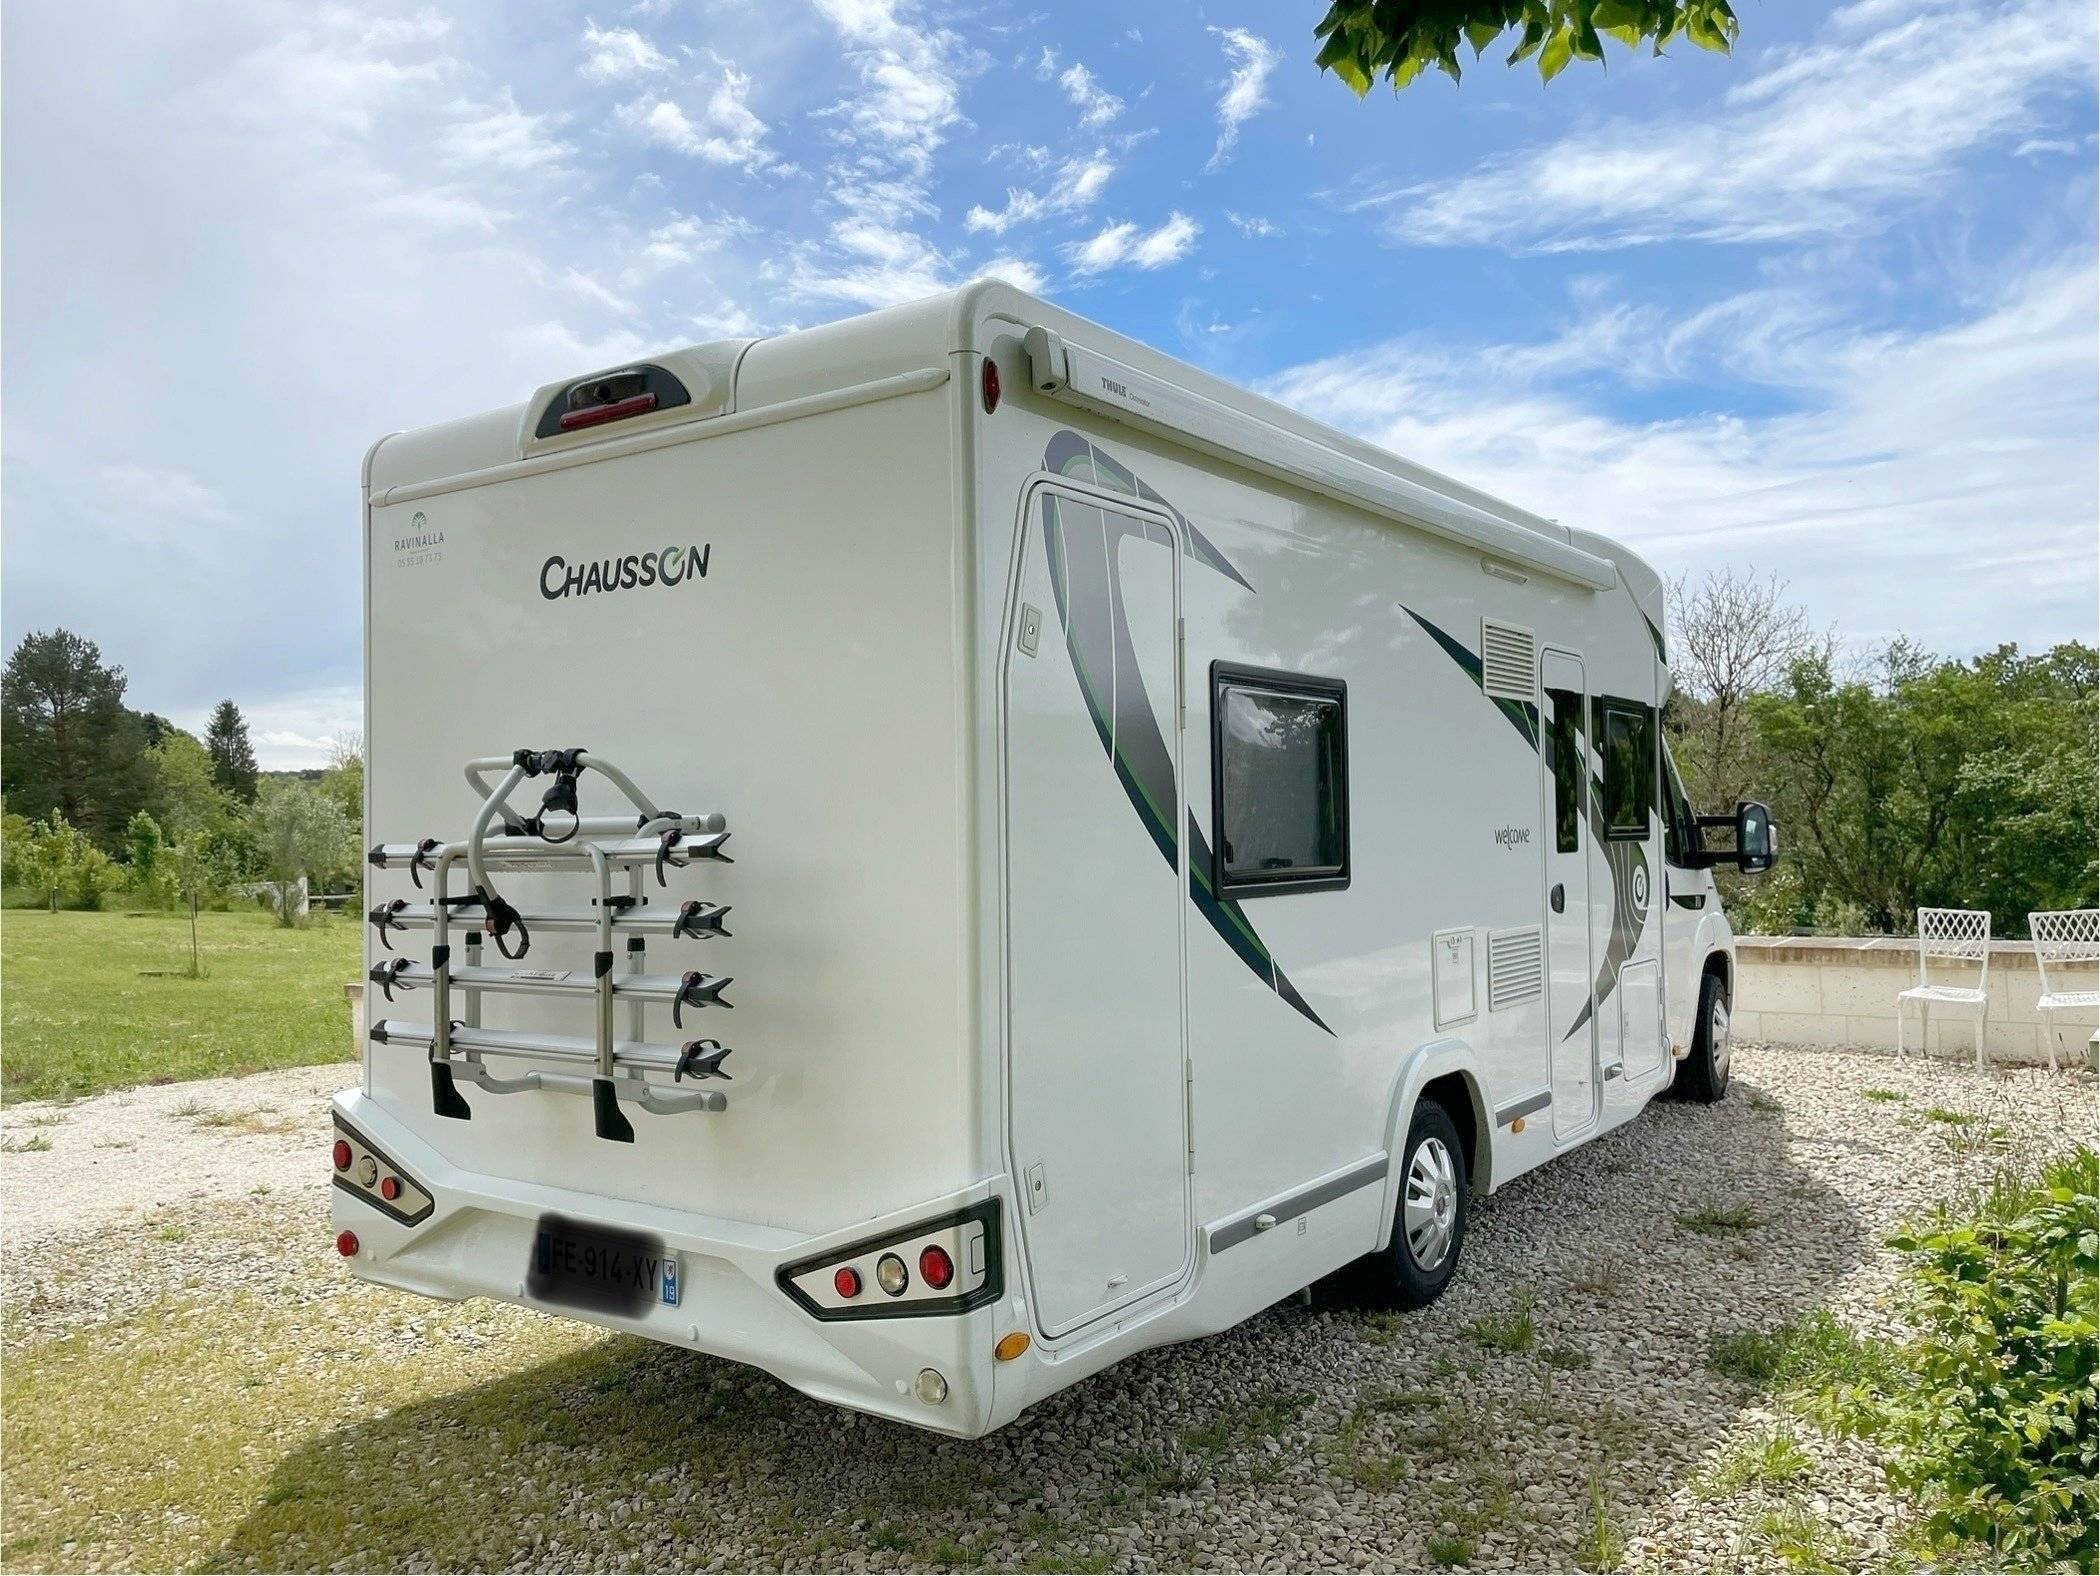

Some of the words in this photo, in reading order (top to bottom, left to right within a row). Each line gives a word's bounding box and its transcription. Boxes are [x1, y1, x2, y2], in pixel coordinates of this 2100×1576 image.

[1101, 377, 1127, 398] THULE
[394, 531, 445, 551] RAVINALLA
[540, 543, 711, 600] CHAUSSON
[1494, 824, 1531, 851] welcome
[551, 1237, 658, 1292] FE-914-XY
[664, 1284, 676, 1301] 19
